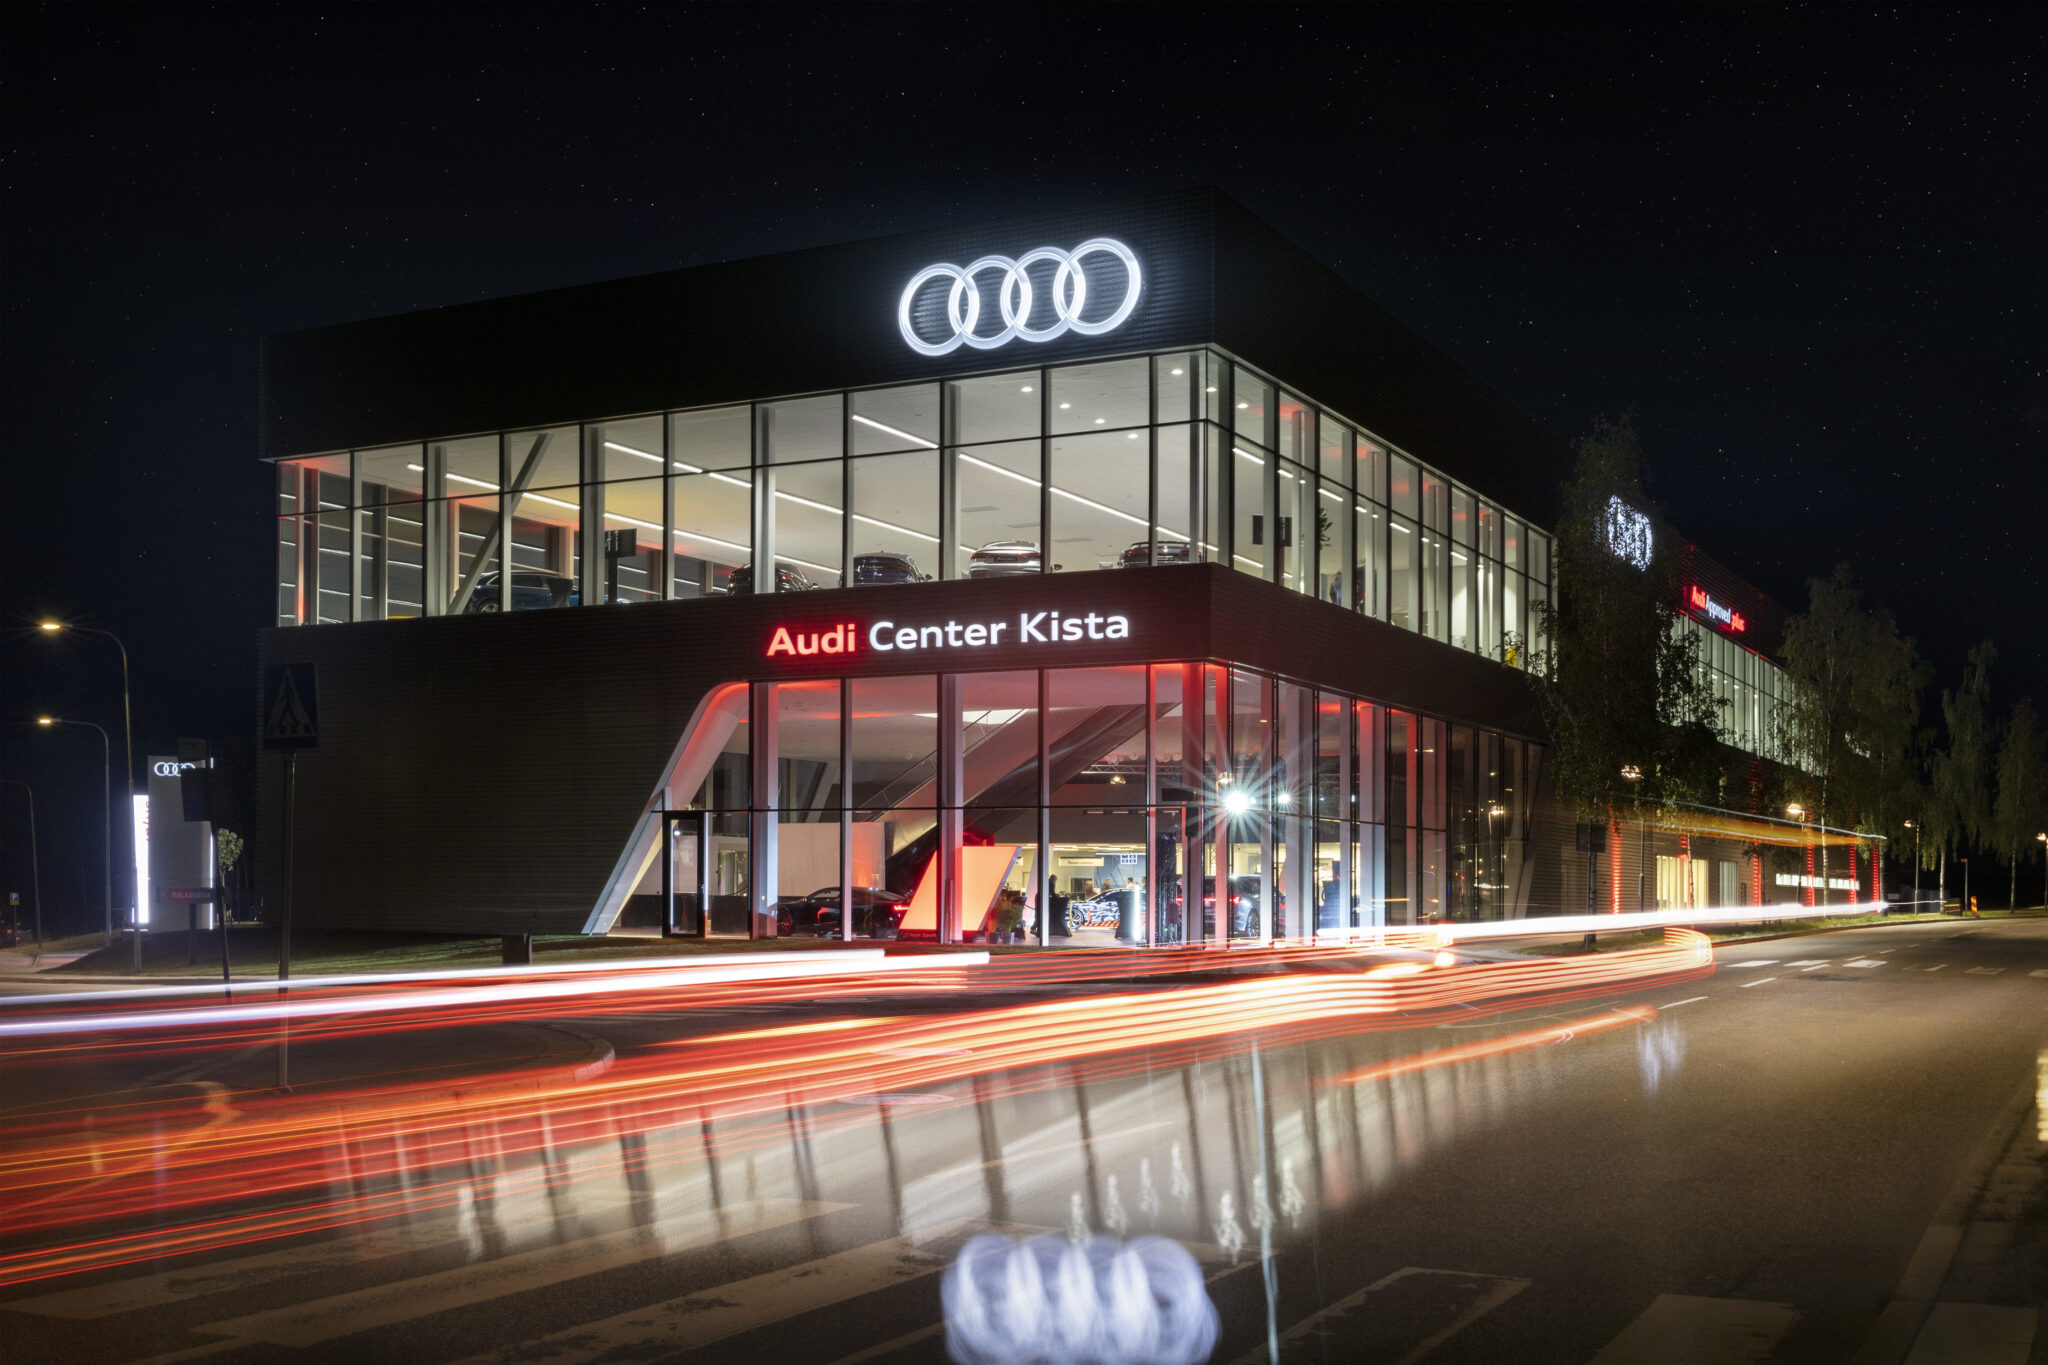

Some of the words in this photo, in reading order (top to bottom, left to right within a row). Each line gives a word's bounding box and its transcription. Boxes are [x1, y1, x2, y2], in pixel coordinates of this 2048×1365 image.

[1691, 585, 1706, 609] Audi
[1705, 595, 1731, 624] Approved
[766, 623, 856, 656] Audi
[869, 621, 1006, 651] Center
[1020, 610, 1130, 643] Kista
